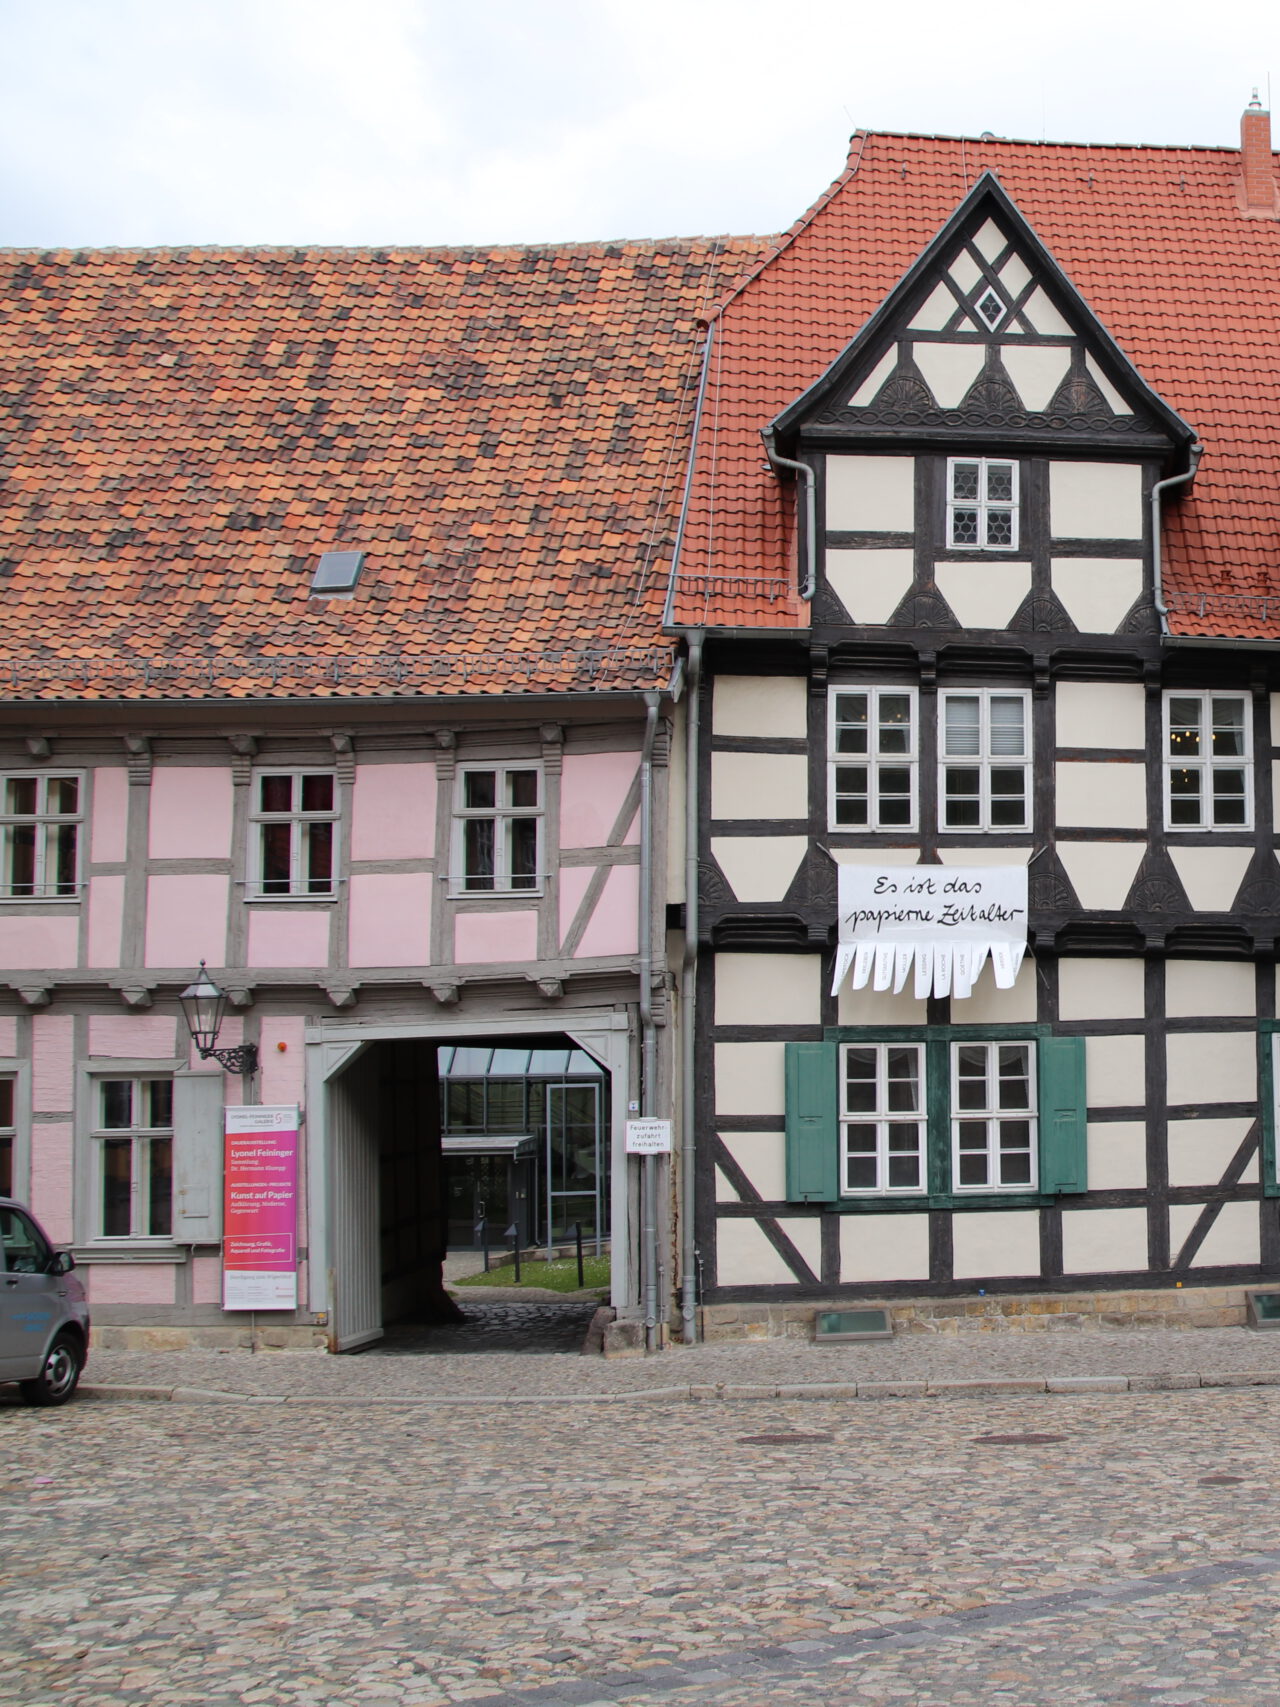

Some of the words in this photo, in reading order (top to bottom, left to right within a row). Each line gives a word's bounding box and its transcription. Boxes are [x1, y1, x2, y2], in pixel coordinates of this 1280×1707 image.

[873, 876, 898, 895] Es
[903, 876, 937, 895] ist
[943, 876, 982, 894] das
[845, 904, 934, 933] papierne
[937, 903, 1024, 926] Zeitalter
[231, 1149, 256, 1158] Lyonel
[257, 1149, 293, 1158] Feininger
[231, 1191, 253, 1199] Kunst
[255, 1191, 267, 1199] auf
[268, 1191, 293, 1200] Papier
